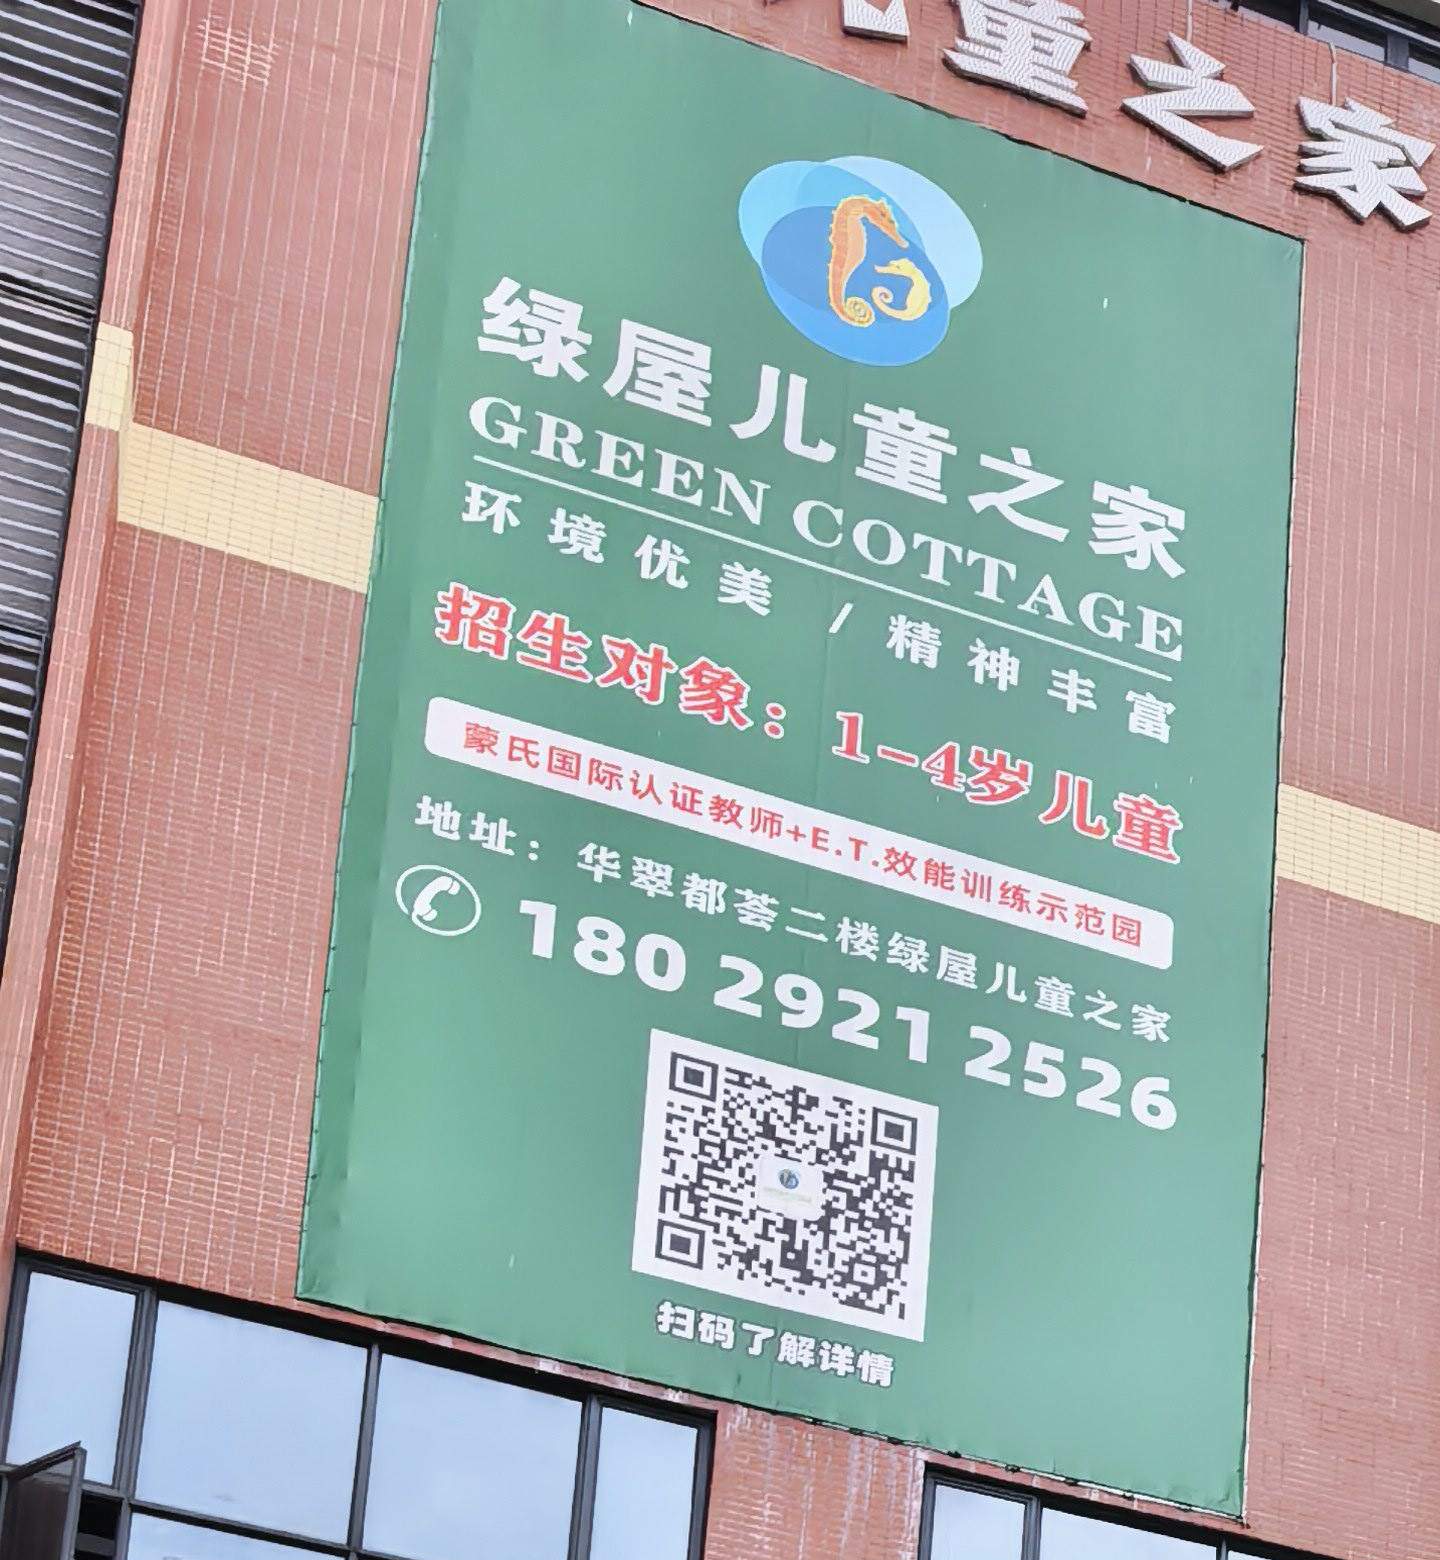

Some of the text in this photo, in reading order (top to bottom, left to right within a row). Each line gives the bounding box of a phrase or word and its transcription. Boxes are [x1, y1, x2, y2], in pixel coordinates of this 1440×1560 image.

[843, 0, 1437, 230] 童之家
[468, 395, 1185, 664] GREEN COTTAGE
[477, 276, 1188, 580] 绿屋儿童之家
[462, 480, 774, 617] 环境优美
[885, 613, 1175, 744] 精神丰富
[518, 897, 1179, 1132] 180 2921 2526
[655, 1299, 896, 1388] 扫码了解详情
